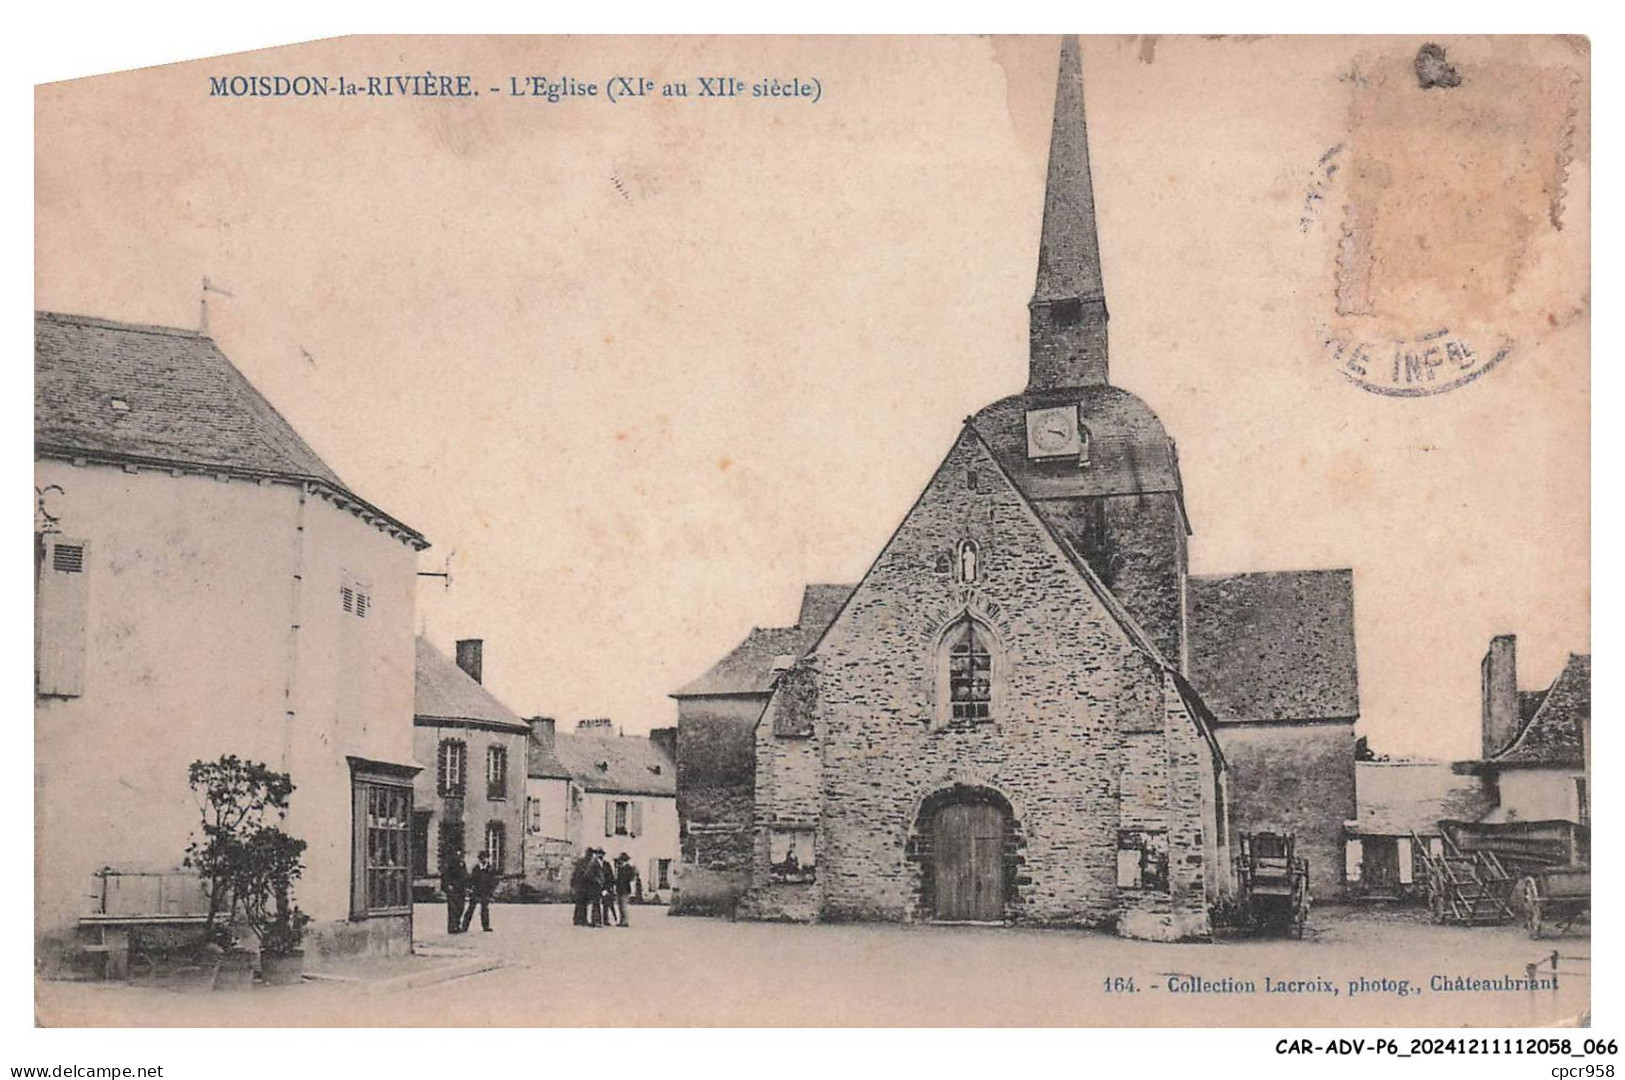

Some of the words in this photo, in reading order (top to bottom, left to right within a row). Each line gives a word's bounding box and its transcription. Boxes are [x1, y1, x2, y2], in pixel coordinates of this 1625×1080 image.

[209, 71, 480, 98] MOISDON-la-RIVIÈRE.
[662, 84, 688, 97] au
[752, 77, 823, 102] siècle)
[1103, 976, 1141, 993] 164.
[1167, 976, 1256, 993] Collection
[1265, 976, 1340, 996] Lacroix,
[1348, 976, 1422, 996] photog.,
[1430, 974, 1559, 992] Châteaubriant
